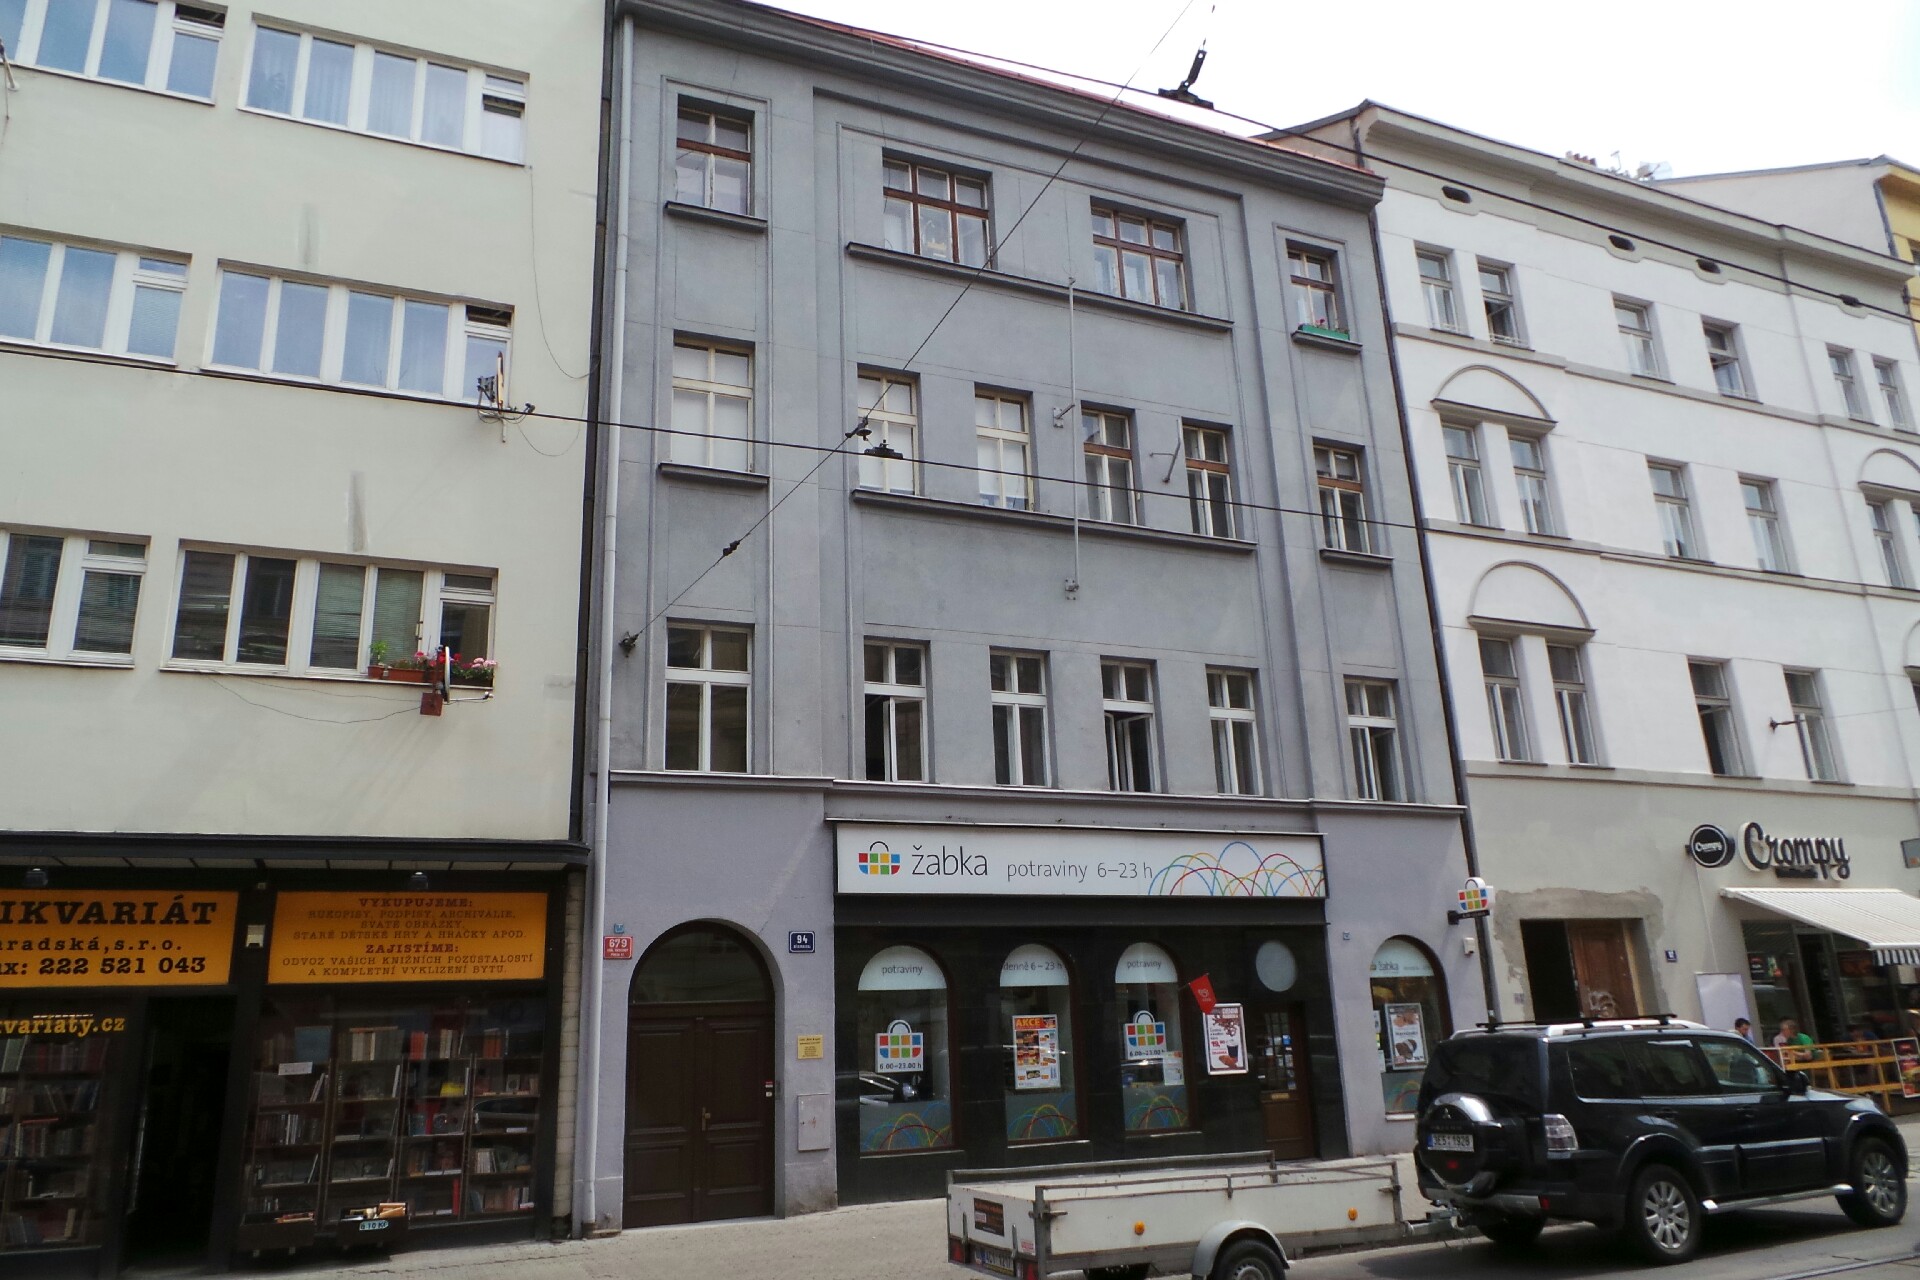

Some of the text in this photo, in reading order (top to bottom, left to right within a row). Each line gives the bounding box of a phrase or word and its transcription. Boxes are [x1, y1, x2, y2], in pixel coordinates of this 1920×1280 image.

[1742, 822, 1850, 880] Crompy
[911, 844, 988, 876] žabka
[1007, 859, 1088, 883] potraviny
[1143, 861, 1153, 879] h
[359, 897, 473, 907] VYKUPUJEME:
[0, 894, 217, 925] IKVARIÁT
[293, 929, 527, 940] STARÉ DĚTSKÉ HRY A HRAČKY APOD.
[796, 934, 809, 944] 94
[0, 936, 182, 953] radská,s.r.o.
[365, 941, 459, 954] ZAJISTÍME:
[609, 938, 628, 949] 679
[0, 956, 206, 975] x: 222 521 043
[282, 957, 325, 966] ODVOZ
[331, 956, 376, 965] VAŠICH
[382, 954, 442, 965] KNIŽNÍCH
[1003, 961, 1029, 971] denně
[1030, 961, 1037, 970] 6
[1045, 961, 1055, 970] 23
[1127, 959, 1161, 970] potraviny
[308, 967, 316, 976] A
[323, 965, 396, 976] KOMPLETNÍ
[402, 964, 467, 975] VYKLIZENÍ
[882, 965, 923, 976] potraviny
[0, 1015, 126, 1037] variaty.cz
[1015, 1018, 1041, 1027] AKCE
